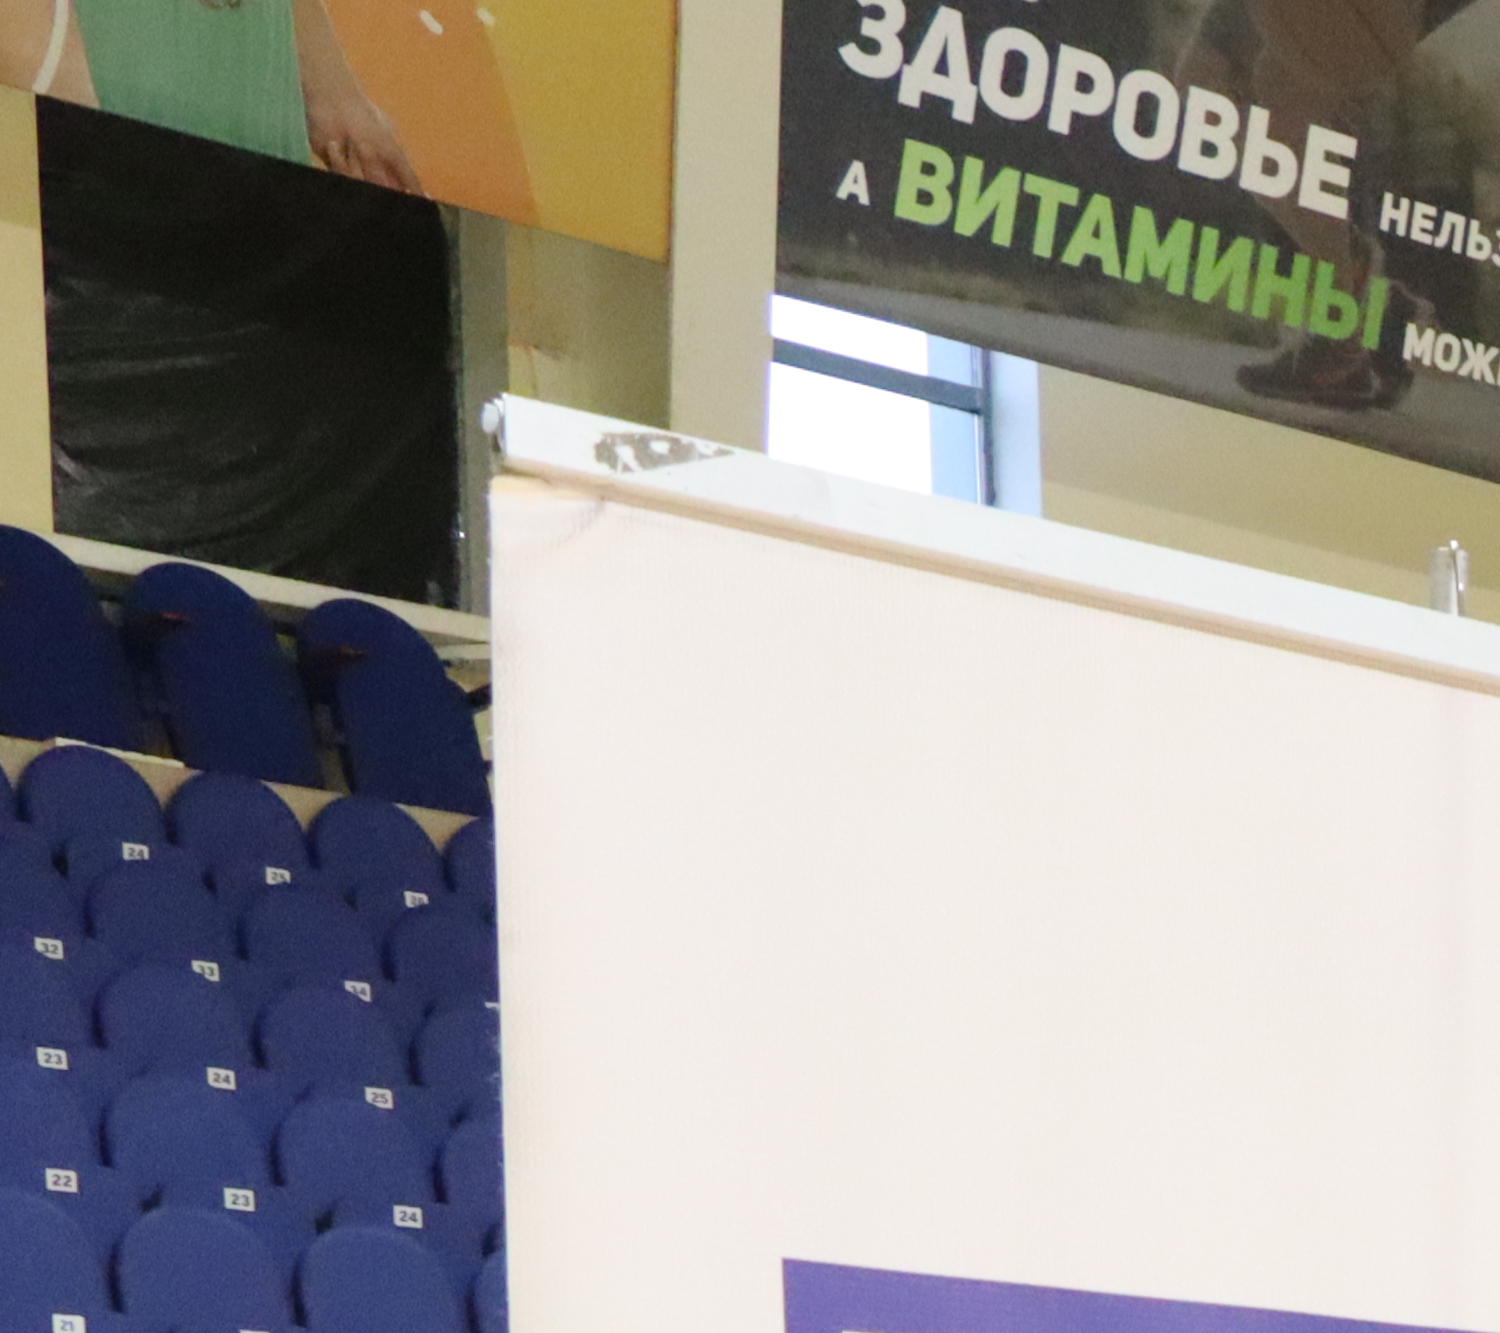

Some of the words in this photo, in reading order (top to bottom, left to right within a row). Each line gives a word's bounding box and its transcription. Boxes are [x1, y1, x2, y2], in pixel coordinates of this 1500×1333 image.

[838, 0, 1358, 220] ЗДОРОВЬЕ
[836, 160, 870, 206] А
[894, 138, 1389, 350] ВИТАМИНЫ
[41, 942, 59, 955] 32
[44, 1052, 63, 1065] 23
[213, 1072, 231, 1085] 24
[371, 1092, 389, 1105] 25
[52, 1173, 72, 1188] 22
[231, 1193, 251, 1208] 23
[399, 1210, 419, 1223] 24
[60, 1319, 75, 1332] 21
